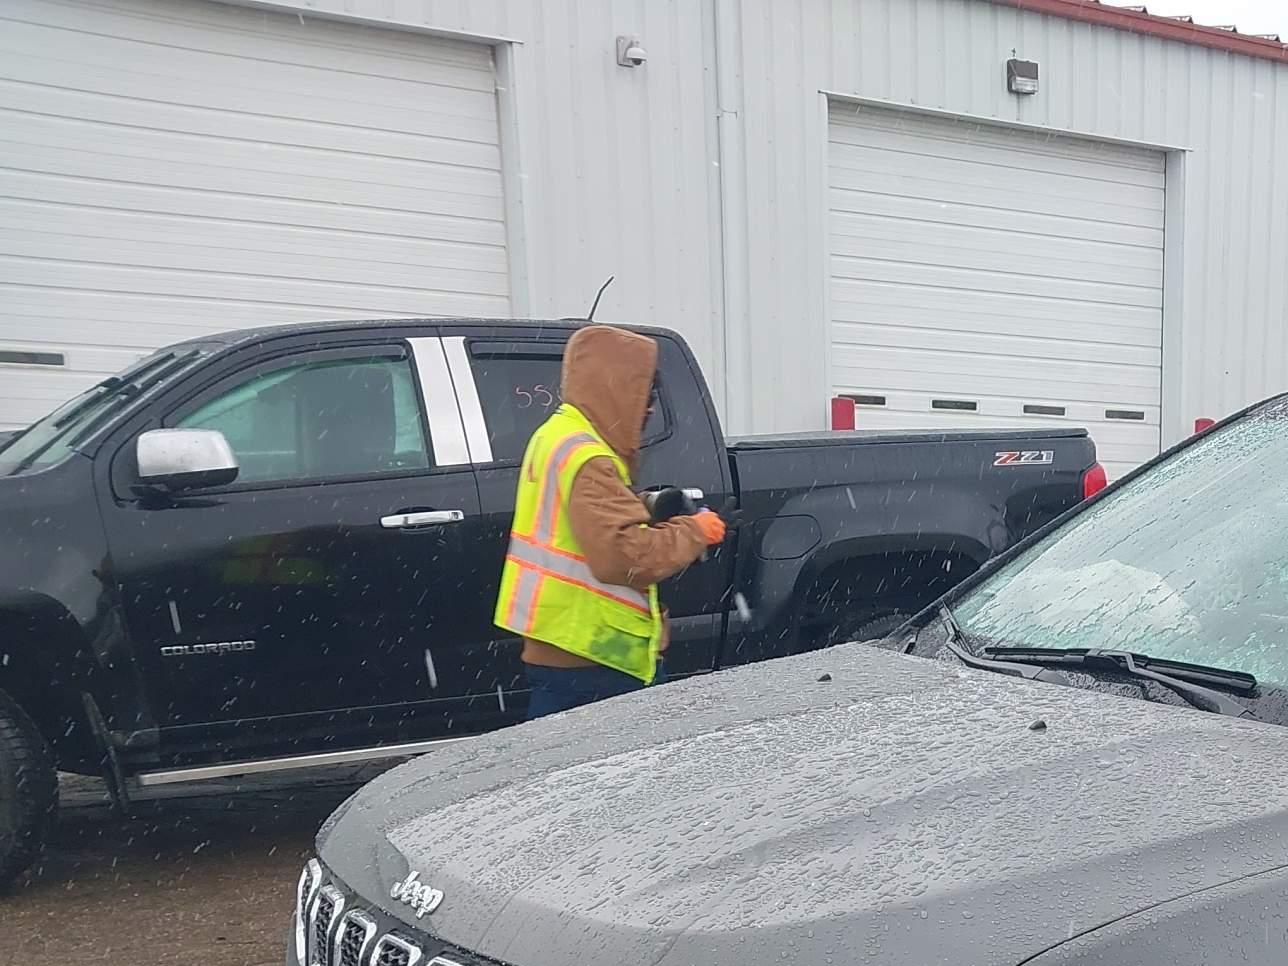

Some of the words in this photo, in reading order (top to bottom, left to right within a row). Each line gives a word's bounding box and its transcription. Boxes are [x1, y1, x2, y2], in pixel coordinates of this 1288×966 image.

[994, 450, 1053, 466] Z71
[160, 640, 256, 656] COLORADO
[390, 870, 444, 919] Jeep
